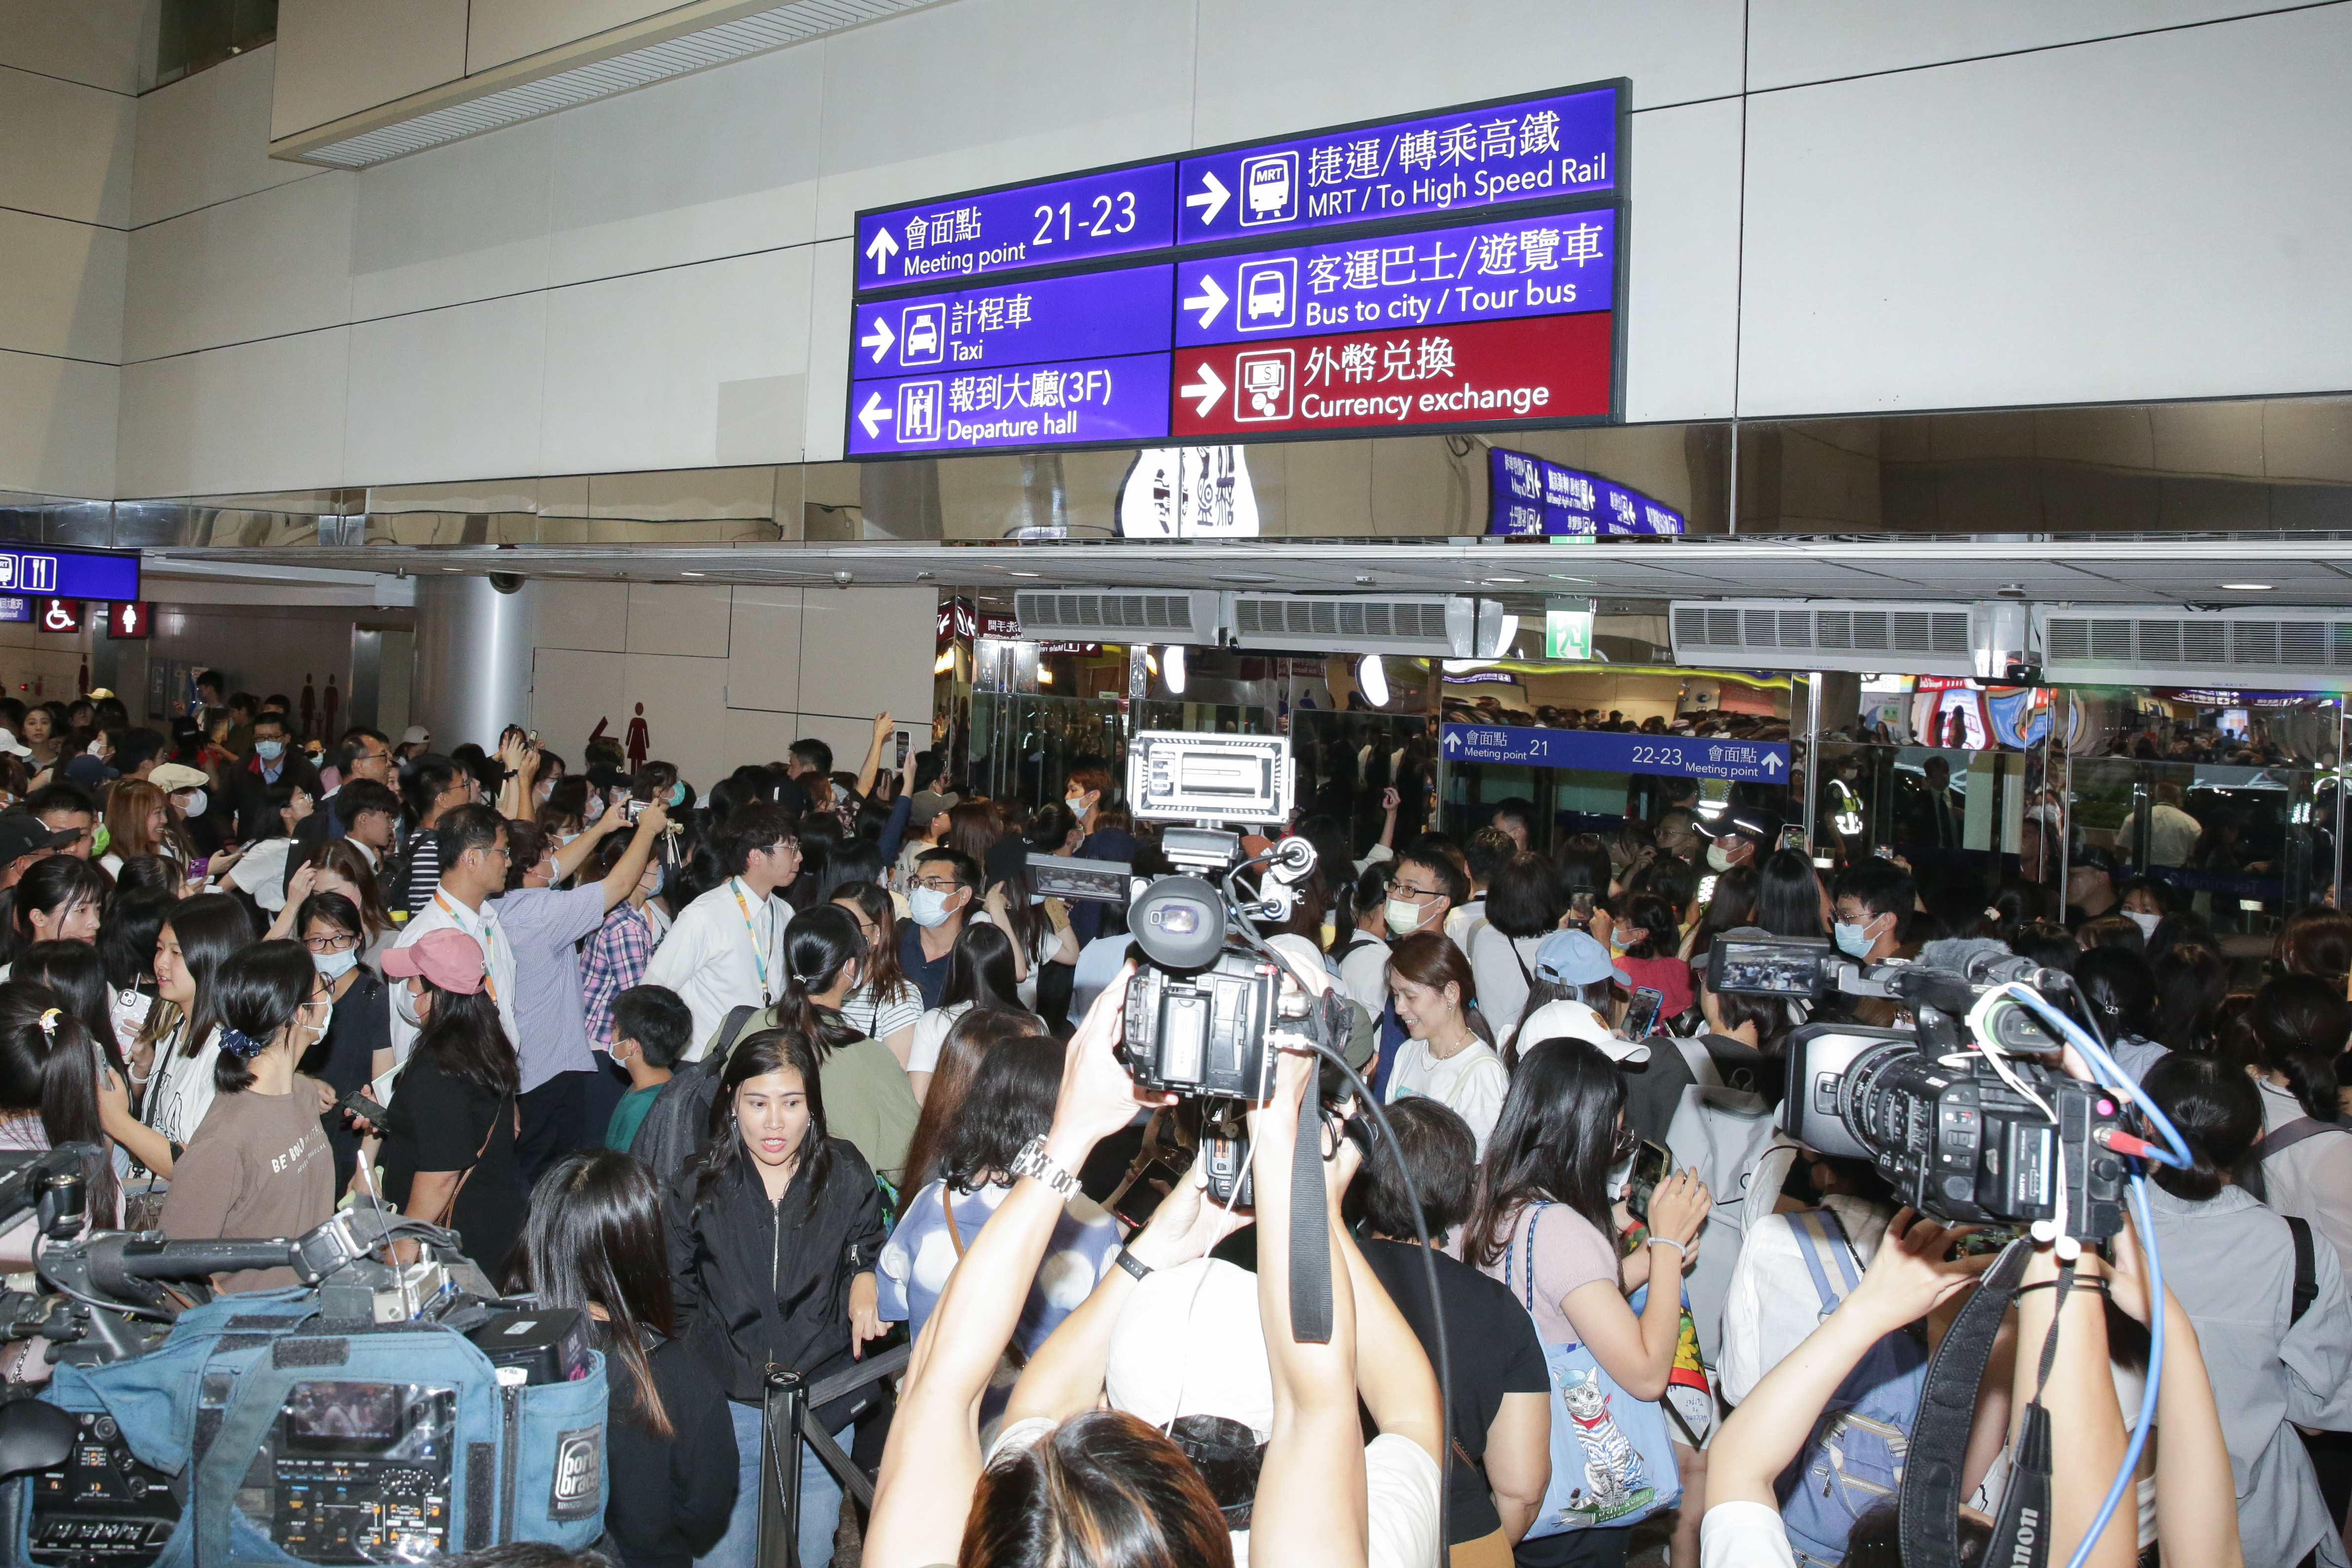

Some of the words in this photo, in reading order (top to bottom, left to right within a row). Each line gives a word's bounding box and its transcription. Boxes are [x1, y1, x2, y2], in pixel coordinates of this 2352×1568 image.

[1306, 109, 1560, 190] 捷運/轉乘高鐵
[1256, 168, 1283, 183] MRT
[1309, 190, 1353, 217] MRT
[1362, 187, 1371, 211] /
[1376, 184, 1404, 208] To
[1413, 173, 1466, 208] High
[1475, 160, 1552, 200] Speed
[1562, 153, 1605, 184] Rail
[905, 206, 982, 250] 會面點
[1033, 192, 1135, 245] 21-23
[905, 251, 973, 276] Meeting
[979, 242, 1025, 269] point
[1307, 223, 1603, 298] 客運巴士/遊覽車
[952, 294, 1032, 335] 計程車
[1307, 303, 1348, 326] Bus
[1355, 301, 1379, 321] to
[1388, 294, 1431, 323] city
[1437, 289, 1449, 314] /
[1461, 282, 1518, 312] Tour
[1527, 279, 1576, 305] bus
[950, 340, 983, 361] Taxi
[1304, 337, 1455, 386] 外幣兌換
[948, 370, 1111, 416] 報到大廳(3F)
[1301, 394, 1412, 420] Currency
[1419, 383, 1549, 414] exchange
[948, 420, 1038, 445] Departure
[1044, 410, 1077, 434] hall
[1465, 747, 1501, 761] Meeting
[1503, 750, 1527, 762] point
[1466, 730, 1507, 747] 會面點
[1530, 740, 1548, 756] 21
[1632, 747, 1682, 765] 22-23
[1708, 745, 1757, 764] 會面點
[1685, 762, 1727, 776] Meeting
[1730, 765, 1758, 777] point
[271, 1154, 287, 1173] BE
[289, 1137, 304, 1161] BOLD
[2009, 1507, 2039, 1568] non
